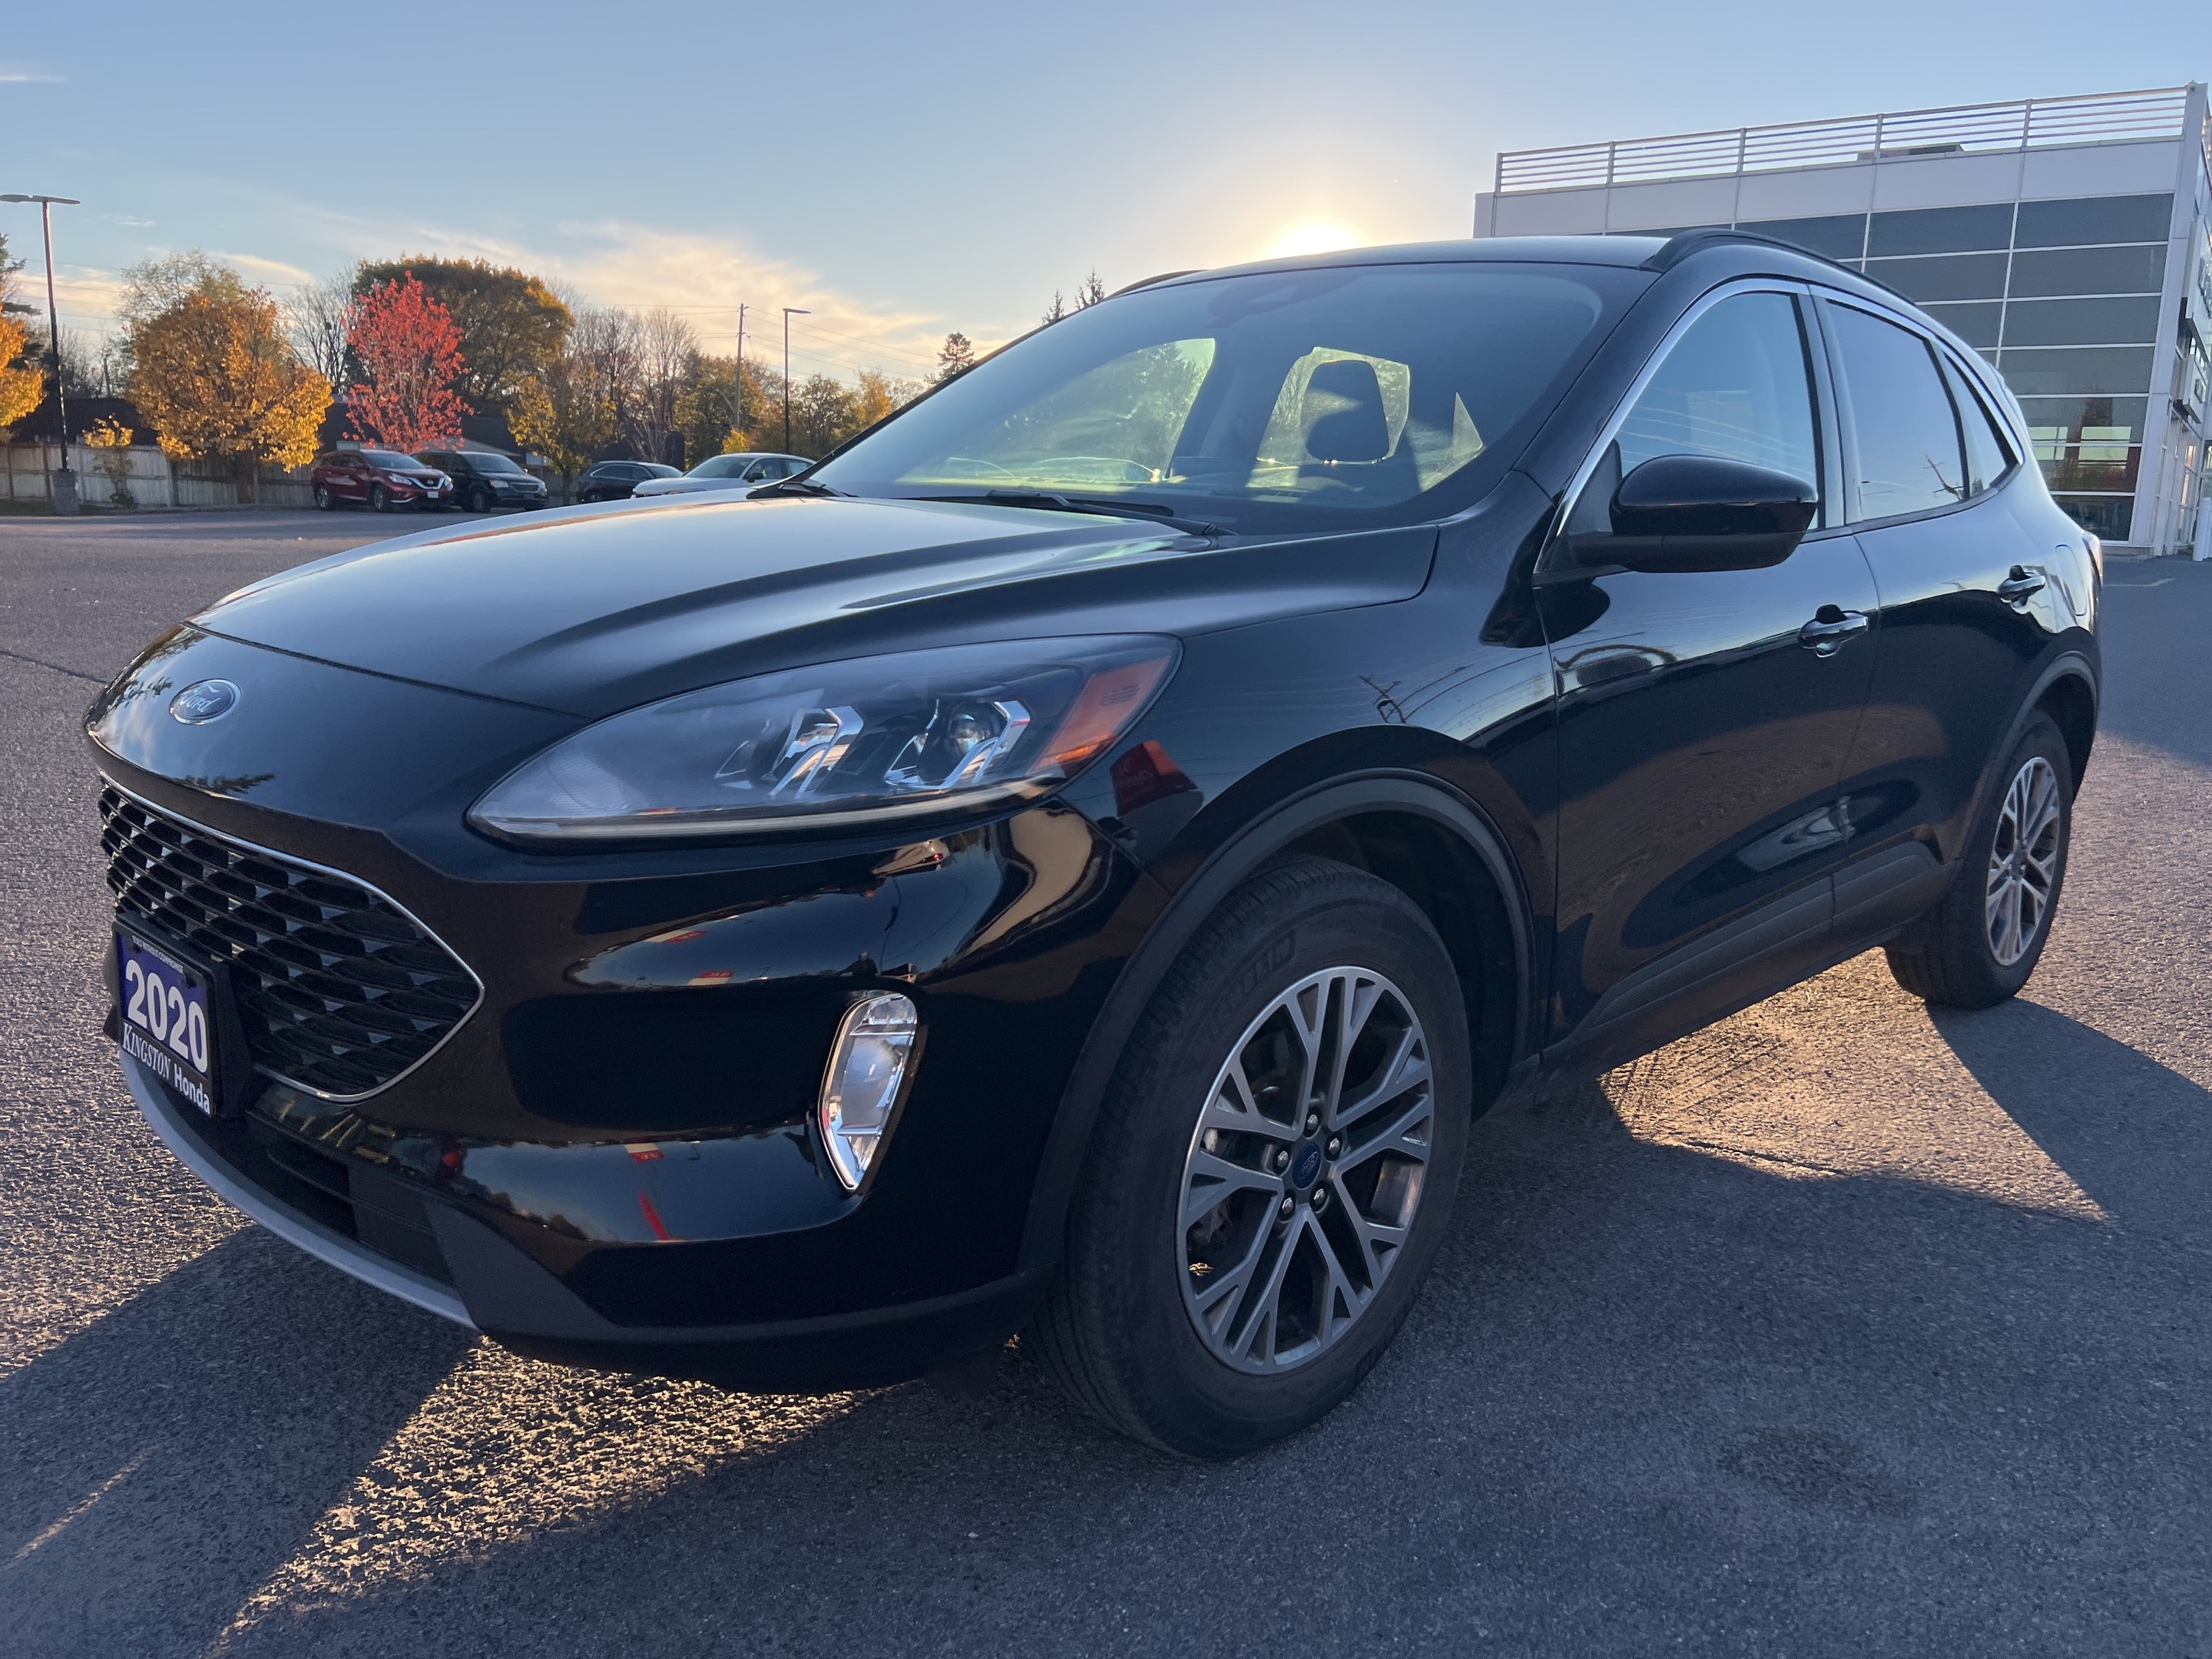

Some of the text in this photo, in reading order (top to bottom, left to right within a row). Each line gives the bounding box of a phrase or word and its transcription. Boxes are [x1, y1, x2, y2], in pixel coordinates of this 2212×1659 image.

[178, 684, 221, 713] Ford
[125, 959, 207, 1073] 2020
[123, 1022, 210, 1114] KINGSTON Honda
